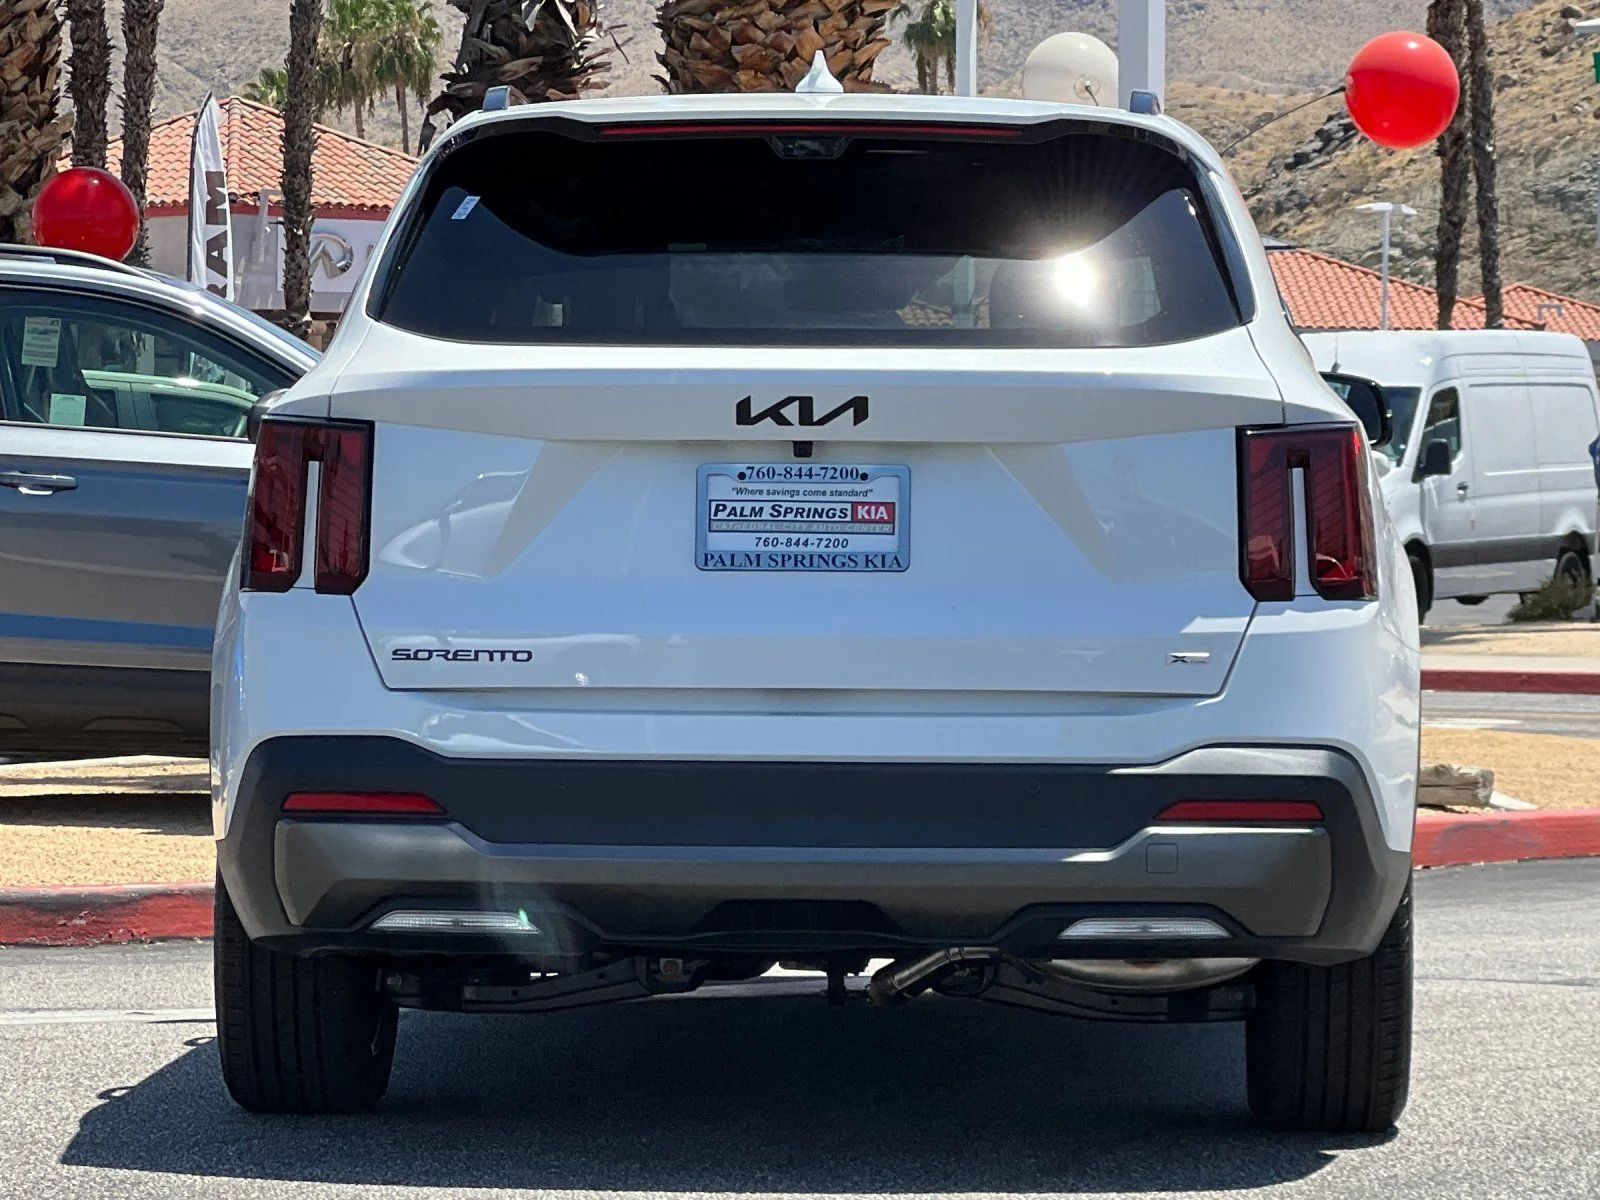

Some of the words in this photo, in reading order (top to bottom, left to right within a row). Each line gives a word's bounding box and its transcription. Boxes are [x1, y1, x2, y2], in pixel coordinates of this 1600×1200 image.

[736, 395, 869, 426] KIA
[745, 466, 859, 480] 760-844-7200
[731, 487, 764, 496] "Where
[766, 488, 800, 498] savings
[803, 489, 827, 497] come
[829, 488, 873, 498] standard"
[713, 503, 764, 518] PALM
[769, 504, 849, 519] SPRINGS
[857, 506, 888, 520] KIA
[713, 522, 776, 531] CATHEDRAL
[782, 523, 807, 532] CITY
[811, 524, 841, 532] AUTO
[846, 524, 891, 533] CENTER
[755, 537, 849, 549] 760-844-7200
[703, 552, 761, 568] PALM
[768, 553, 858, 569] SPRINGS
[864, 554, 903, 569] KIA
[391, 648, 533, 663] SORENTO
